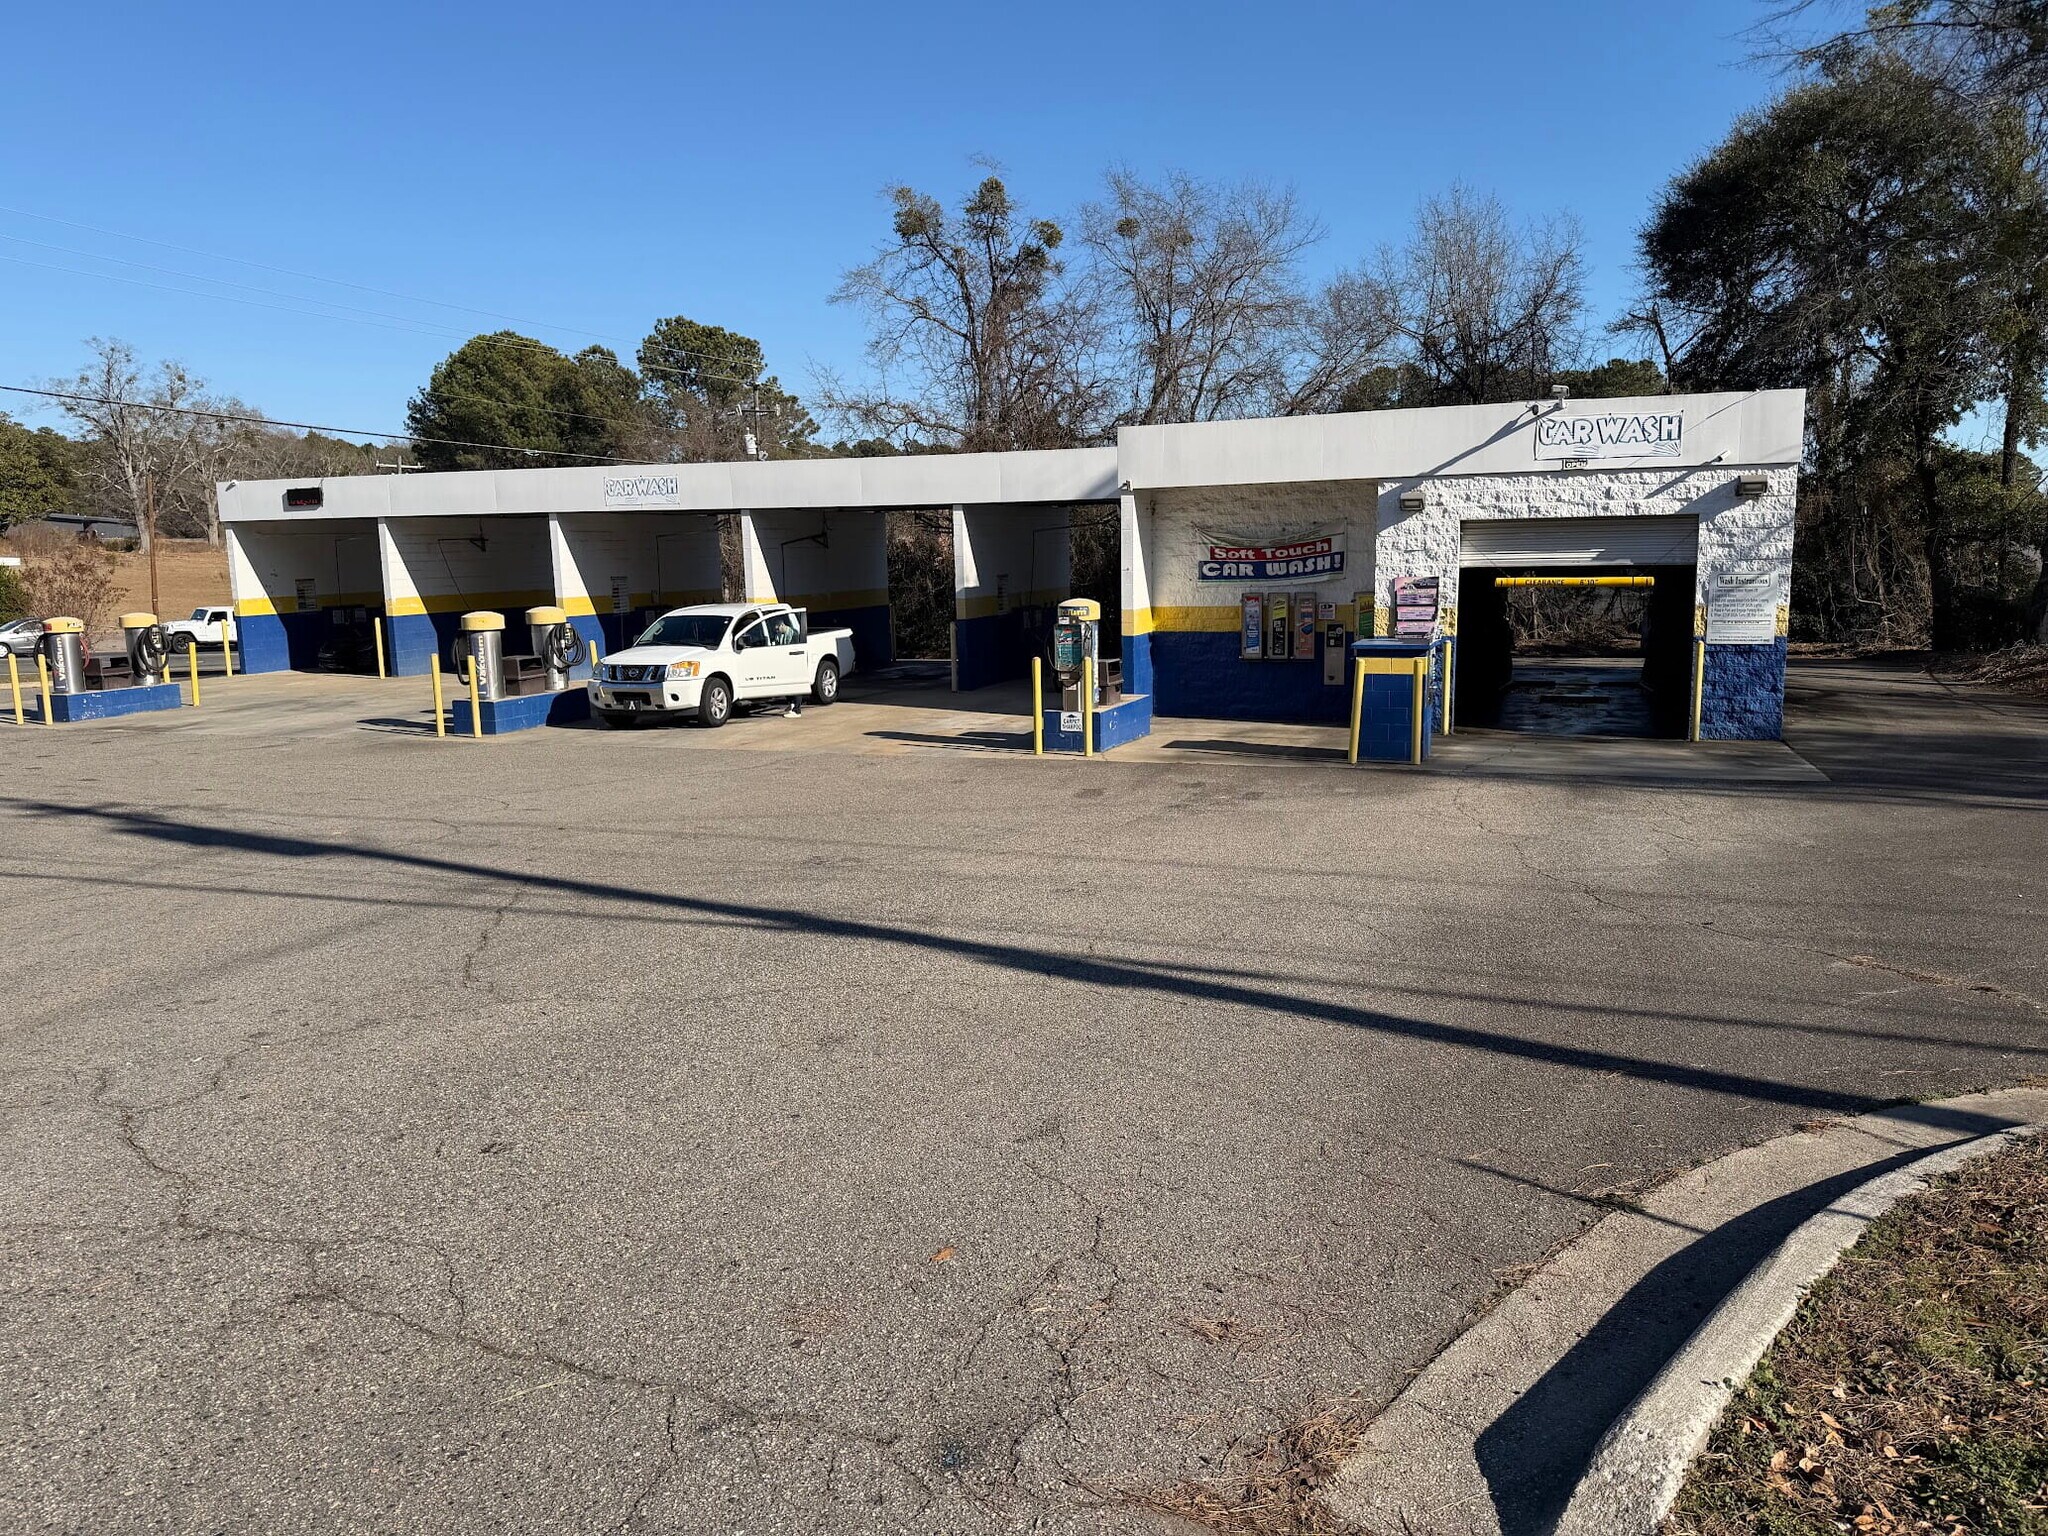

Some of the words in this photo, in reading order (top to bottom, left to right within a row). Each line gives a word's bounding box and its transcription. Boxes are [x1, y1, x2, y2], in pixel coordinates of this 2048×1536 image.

[1539, 418, 1594, 446] CAR
[1597, 415, 1682, 444] WASH
[606, 479, 635, 497] CAR
[634, 477, 679, 496] WASH
[1214, 548, 1256, 560] Soft
[1261, 541, 1329, 559] Touch
[1202, 562, 1255, 577] CAR
[1266, 554, 1341, 576] WASH!
[1719, 576, 1734, 585] Wash
